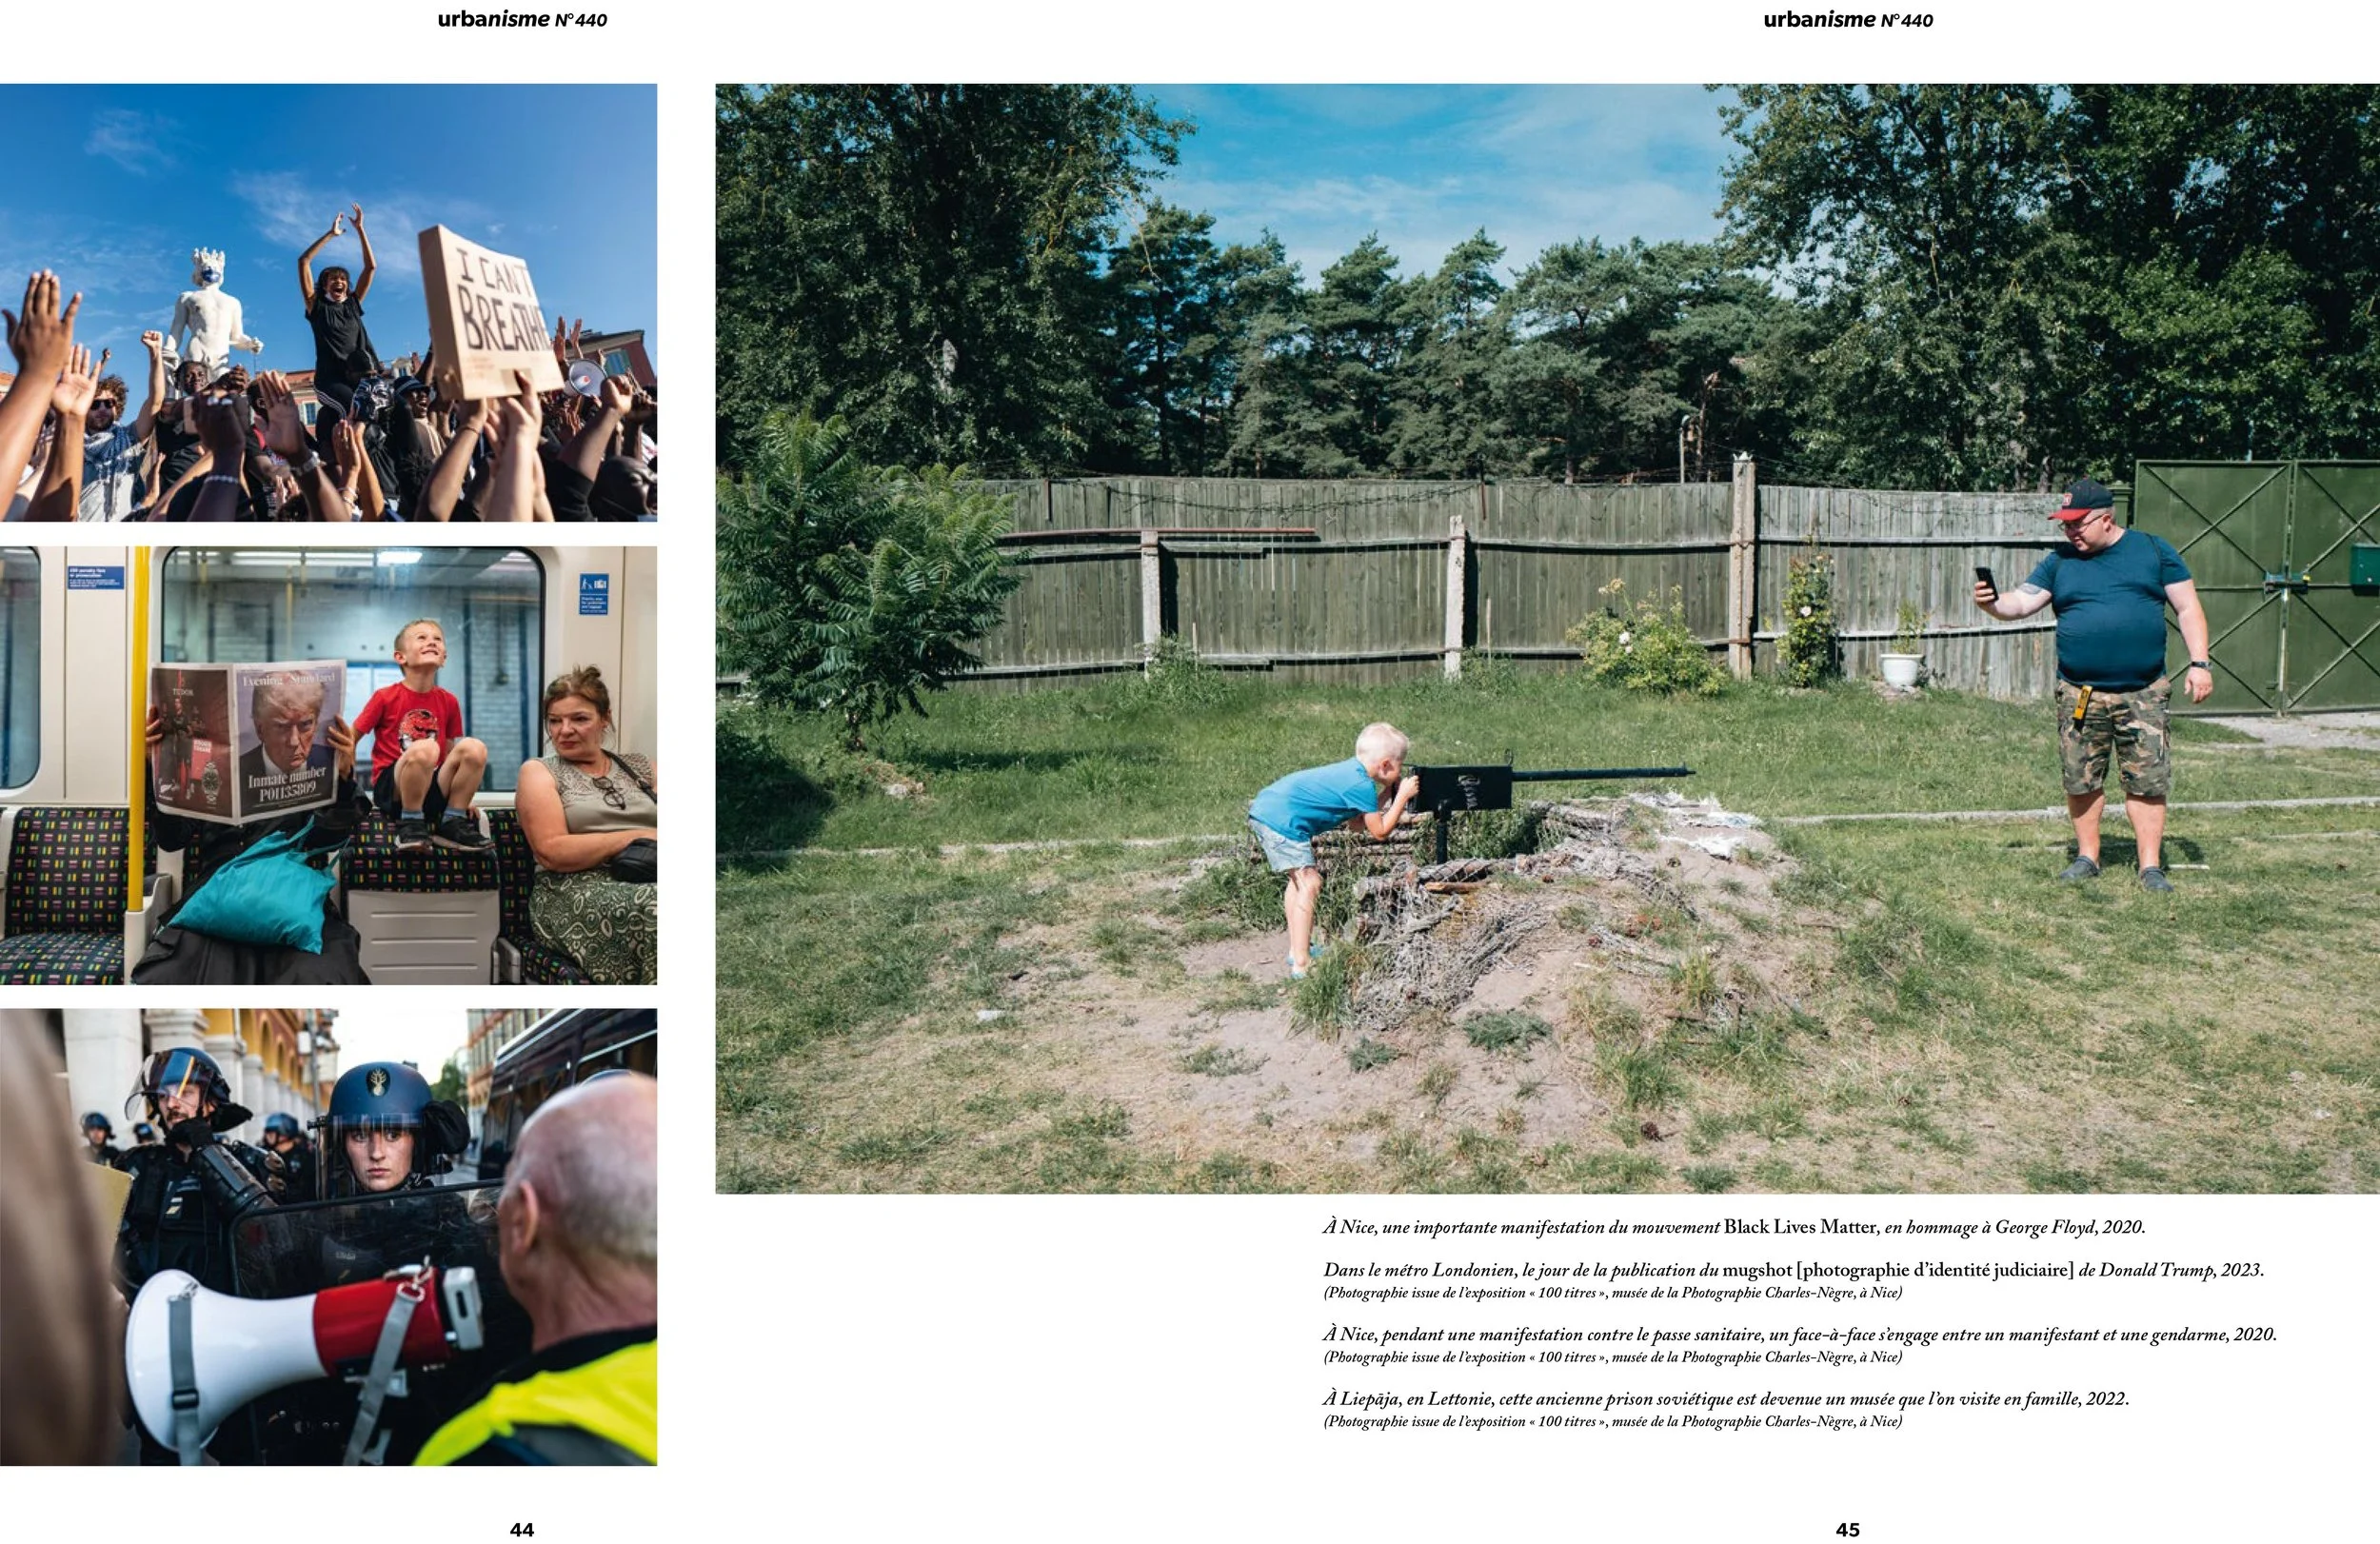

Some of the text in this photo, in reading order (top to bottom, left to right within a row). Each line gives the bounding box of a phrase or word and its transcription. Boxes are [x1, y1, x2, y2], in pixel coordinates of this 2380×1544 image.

[438, 10, 550, 28] urbanisme
[1764, 10, 1876, 28] urbanisme
[457, 247, 473, 282] I
[243, 672, 335, 686] Evening Standard
[248, 766, 327, 788] Inmate number
[259, 781, 317, 802] P01135809
[1322, 1216, 2145, 1239] À Nice, une importante manifestation du mouvement Black Lives Matter, en hommage à George Floyd, 2020.
[1323, 1261, 2264, 1282] Dans le métro Londonien, le jour de la publication du mugshot [photographie d’identité judiciaire] de Donald Trump, 2023.
[1324, 1286, 1408, 1302] (Photographie
[1412, 1287, 1439, 1297] issue
[1442, 1287, 1456, 1297] de
[1459, 1287, 1525, 1302] l’exposition
[1538, 1287, 1562, 1297] 100
[1564, 1287, 1596, 1297] titres
[1613, 1288, 1647, 1297] musée
[1651, 1287, 1664, 1297] de
[1667, 1287, 1678, 1297] la
[1681, 1287, 1761, 1302] Photographie
[1766, 1287, 1856, 1302] Charles-Nègre,
[1860, 1288, 1867, 1297] à
[1870, 1286, 1902, 1300] Nice)
[1321, 1323, 1337, 1340] À
[1339, 1327, 1378, 1343] Nice,
[1379, 1327, 1444, 1346] pendant
[1479, 1327, 1582, 1346] manifestation
[1588, 1330, 1634, 1340] contre
[1637, 1327, 1649, 1340] le
[1651, 1330, 1691, 1346] passe
[1695, 1328, 1764, 1343] sanitaire,
[1789, 1327, 1875, 1346] face-à-face
[1878, 1327, 1938, 1346] s’engage
[1942, 1330, 1981, 1340] entre
[2010, 1327, 2100, 1346] manifestant
[2103, 1330, 2117, 1340] et
[2150, 1327, 2229, 1346] gendarme,
[2233, 1327, 2276, 1340] 2020.
[1324, 1350, 1408, 1367] (Photographie
[1412, 1352, 1439, 1362] issue
[1443, 1351, 1456, 1362] de
[1459, 1351, 1525, 1367] l’exposition
[1538, 1352, 1562, 1362] 100
[1565, 1352, 1597, 1362] titres
[1613, 1352, 1647, 1362] musée
[1651, 1351, 1664, 1362] de
[1667, 1351, 1678, 1362] la
[1682, 1351, 1761, 1367] Photographie
[1766, 1351, 1856, 1367] Charles-Nègre,
[1860, 1352, 1867, 1362] à
[1870, 1350, 1902, 1365] Nice)
[1321, 1387, 2129, 1411] À Liepāja, en Lettonie, cette ancienne prison soviétique est devenue un musée que l’on visite en famille, 2022.
[1324, 1415, 1408, 1431] (Photographie
[1412, 1416, 1439, 1427] issue
[1443, 1415, 1456, 1426] de
[1459, 1415, 1525, 1431] l’exposition
[1538, 1415, 1562, 1427] 100
[1564, 1416, 1596, 1427] titres
[1613, 1416, 1647, 1427] musée
[1651, 1415, 1664, 1426] de
[1667, 1415, 1678, 1426] la
[1682, 1415, 1761, 1431] Photographie
[1766, 1415, 1856, 1431] Charles-Nègre,
[1860, 1416, 1867, 1426] à
[1870, 1415, 1902, 1430] Nice)
[510, 1523, 534, 1537] 44
[1835, 1523, 1860, 1537] 45
